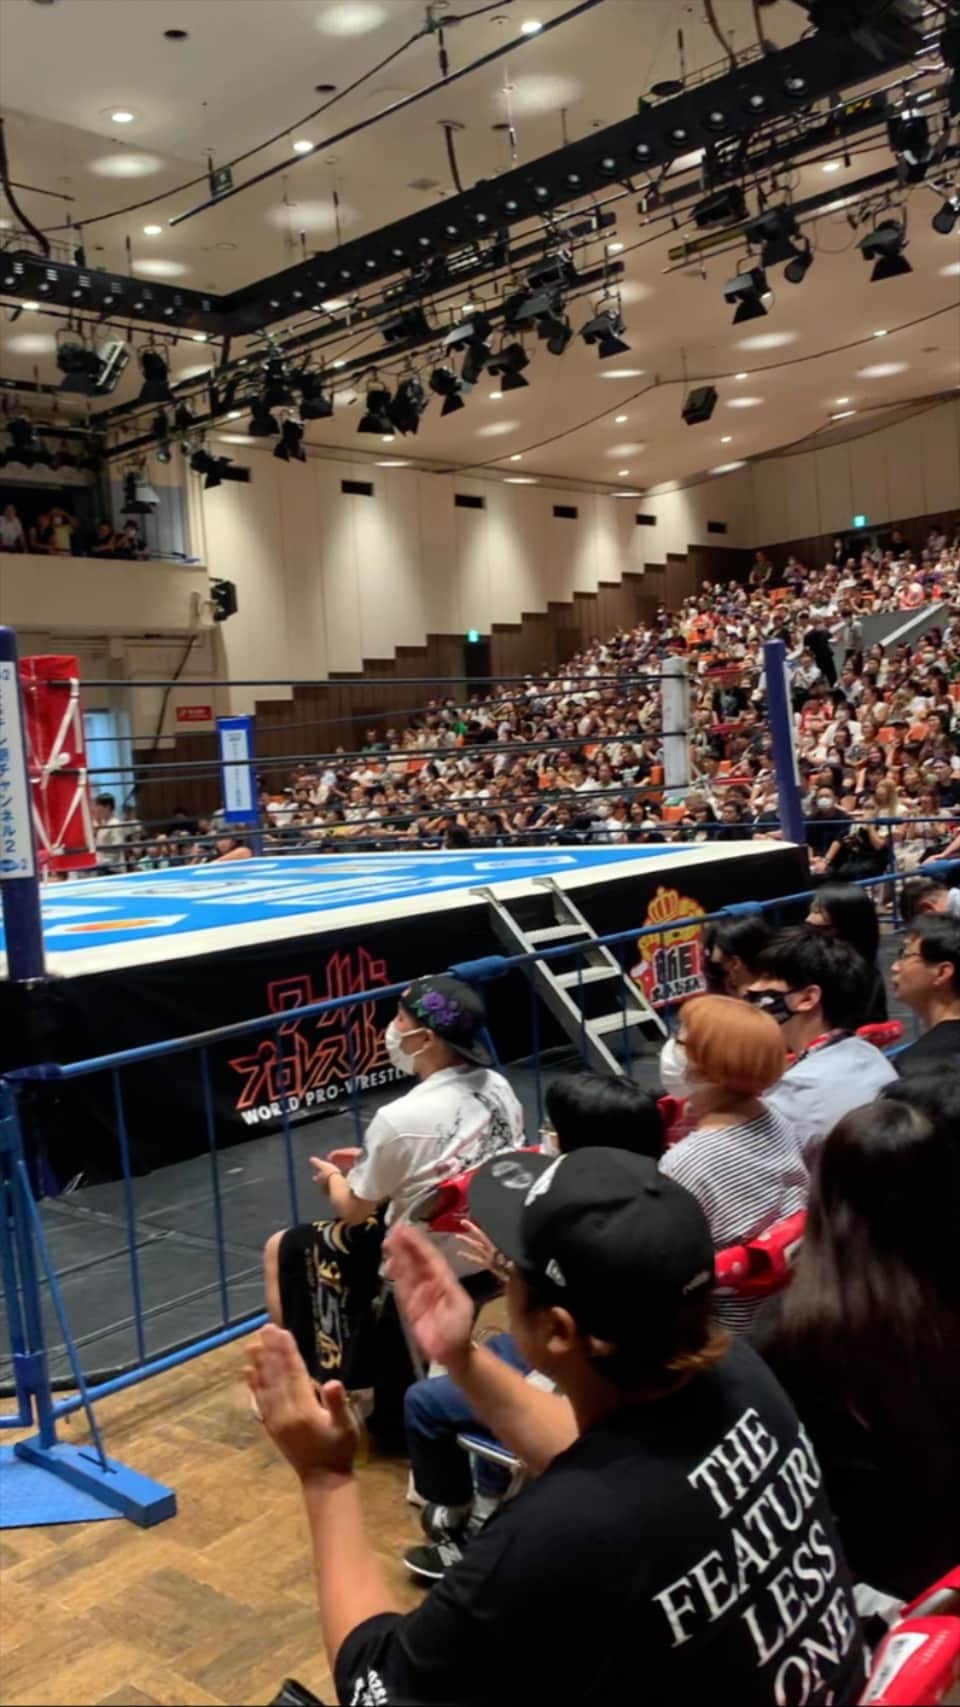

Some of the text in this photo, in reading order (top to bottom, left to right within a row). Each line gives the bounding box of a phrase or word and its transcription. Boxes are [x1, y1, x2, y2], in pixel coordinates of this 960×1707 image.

[687, 1407, 779, 1520] THE
[741, 1519, 837, 1668] LESS
[774, 1587, 856, 1707] ONE
